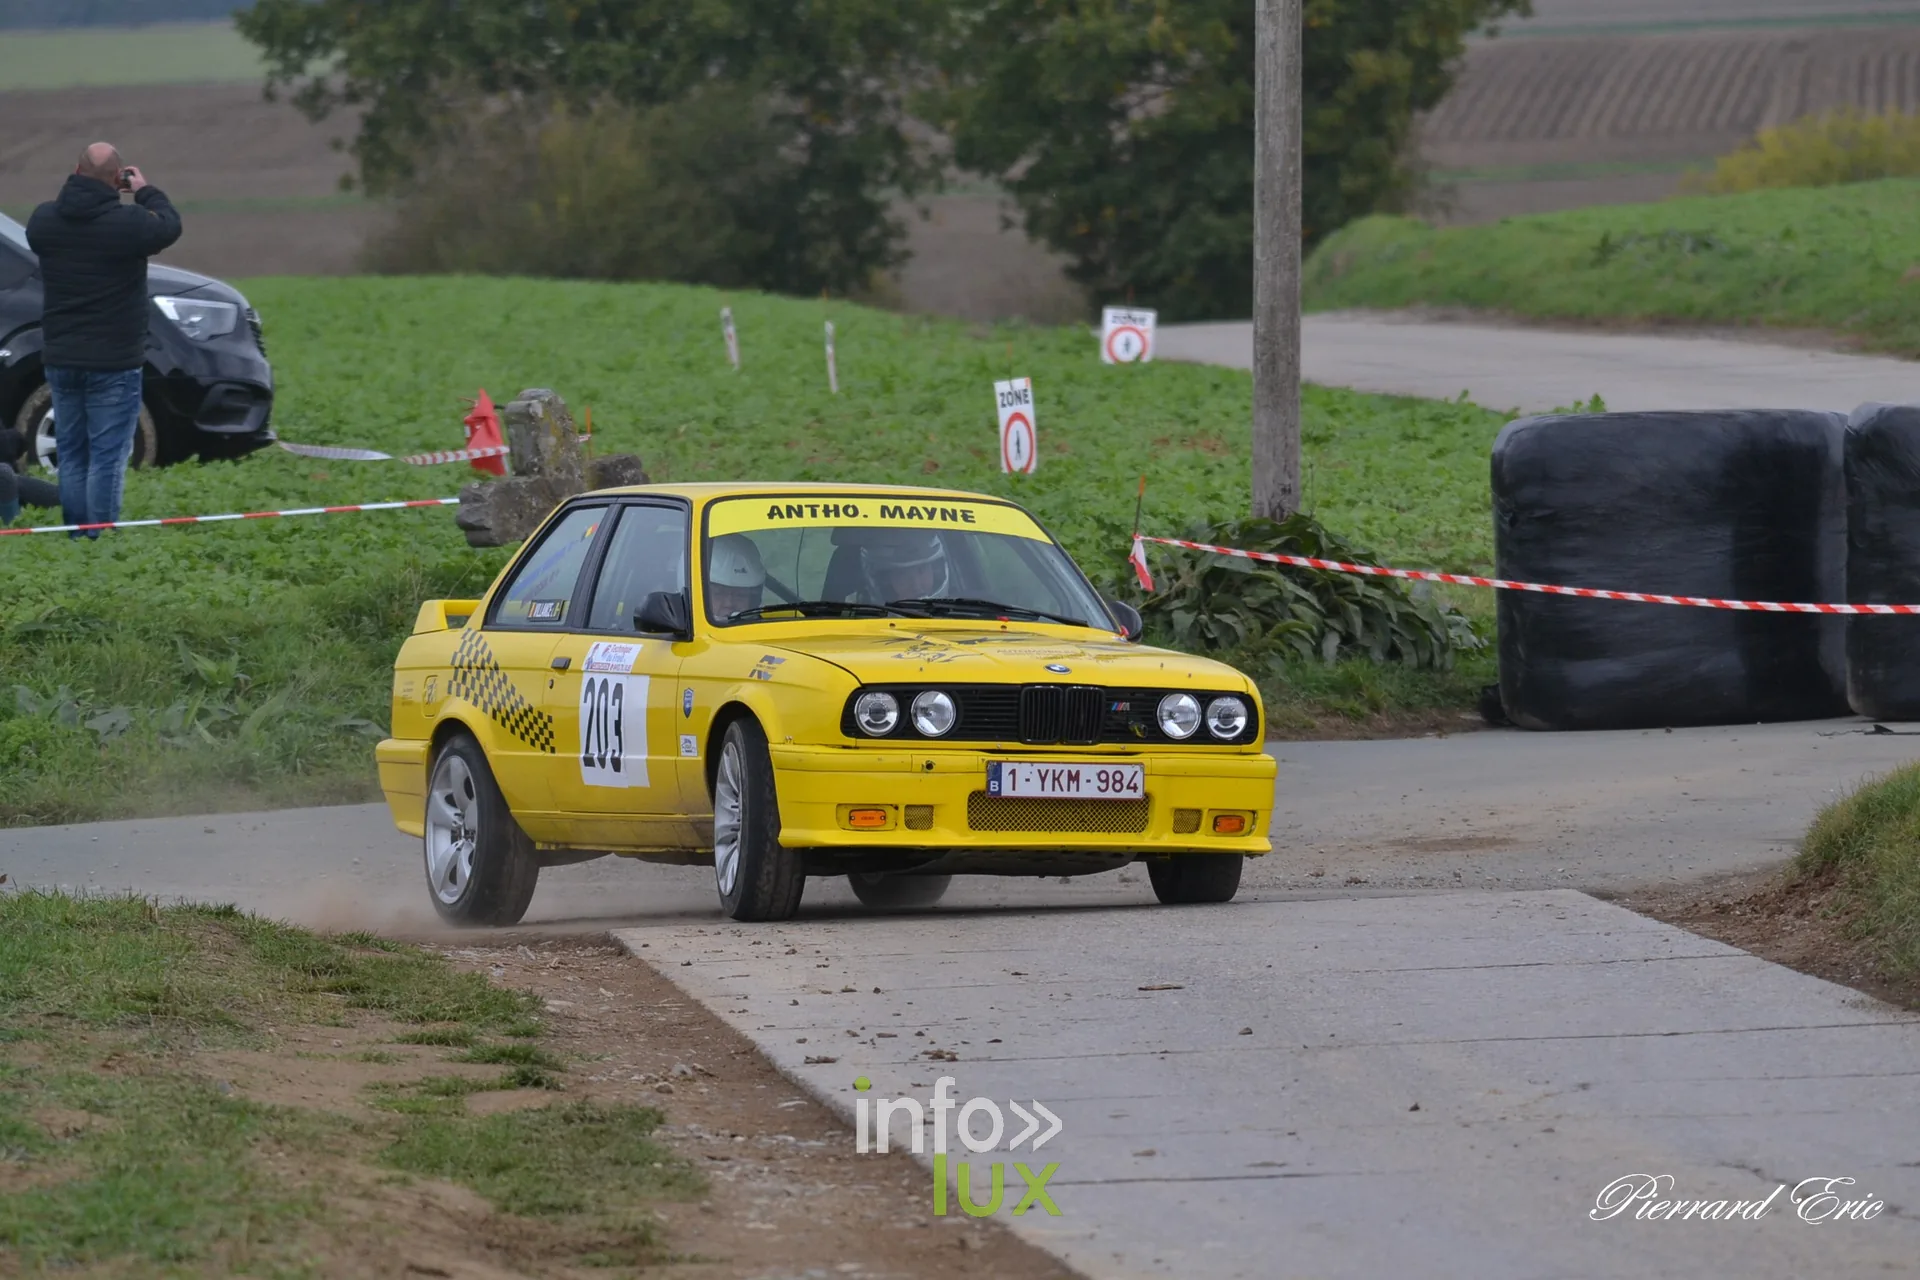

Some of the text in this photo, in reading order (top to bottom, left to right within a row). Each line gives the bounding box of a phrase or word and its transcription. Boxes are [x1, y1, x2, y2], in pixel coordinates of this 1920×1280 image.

[999, 388, 1031, 408] ZONE
[767, 503, 977, 524] ANTHO. MAYNE
[583, 677, 623, 773] 203
[989, 781, 999, 792] B
